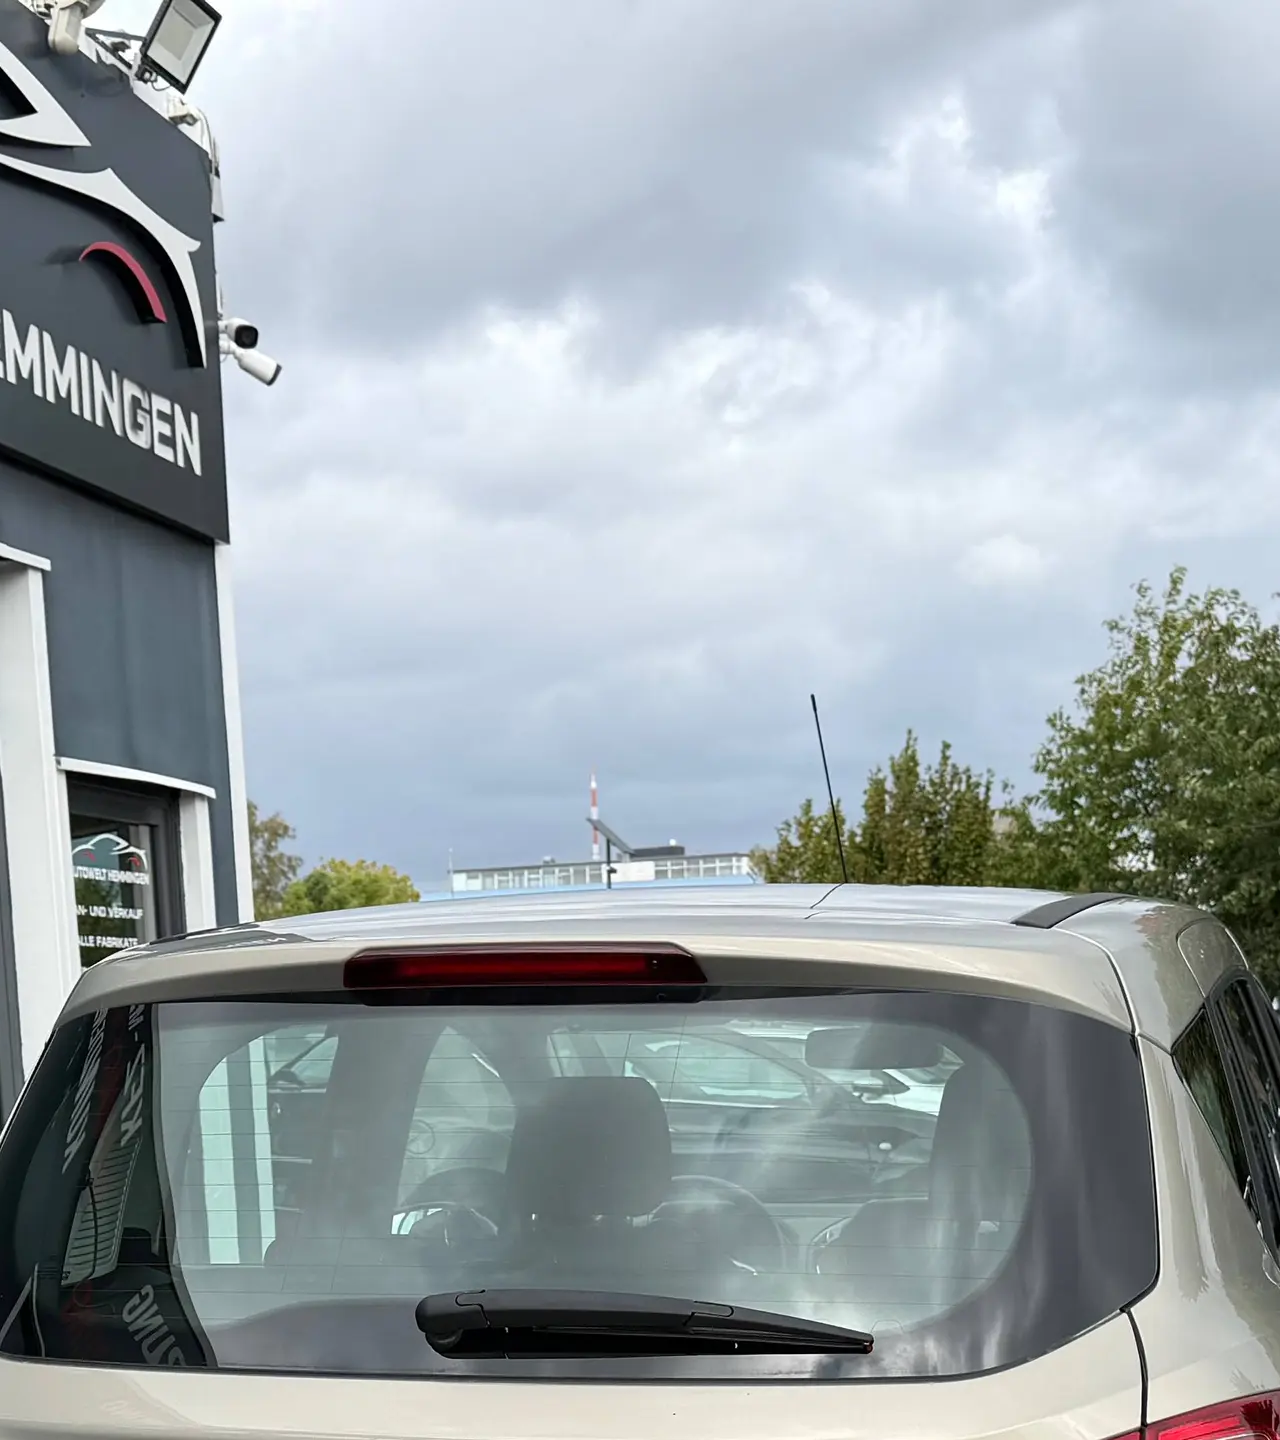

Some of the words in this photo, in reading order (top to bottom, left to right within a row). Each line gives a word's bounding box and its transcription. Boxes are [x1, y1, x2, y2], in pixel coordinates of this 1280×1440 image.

[74, 866, 106, 881] UTOWELT
[89, 906, 106, 917] UND
[108, 908, 143, 919] VERKAUF
[79, 935, 95, 946] LLE
[96, 936, 138, 948] FABRIKATE
